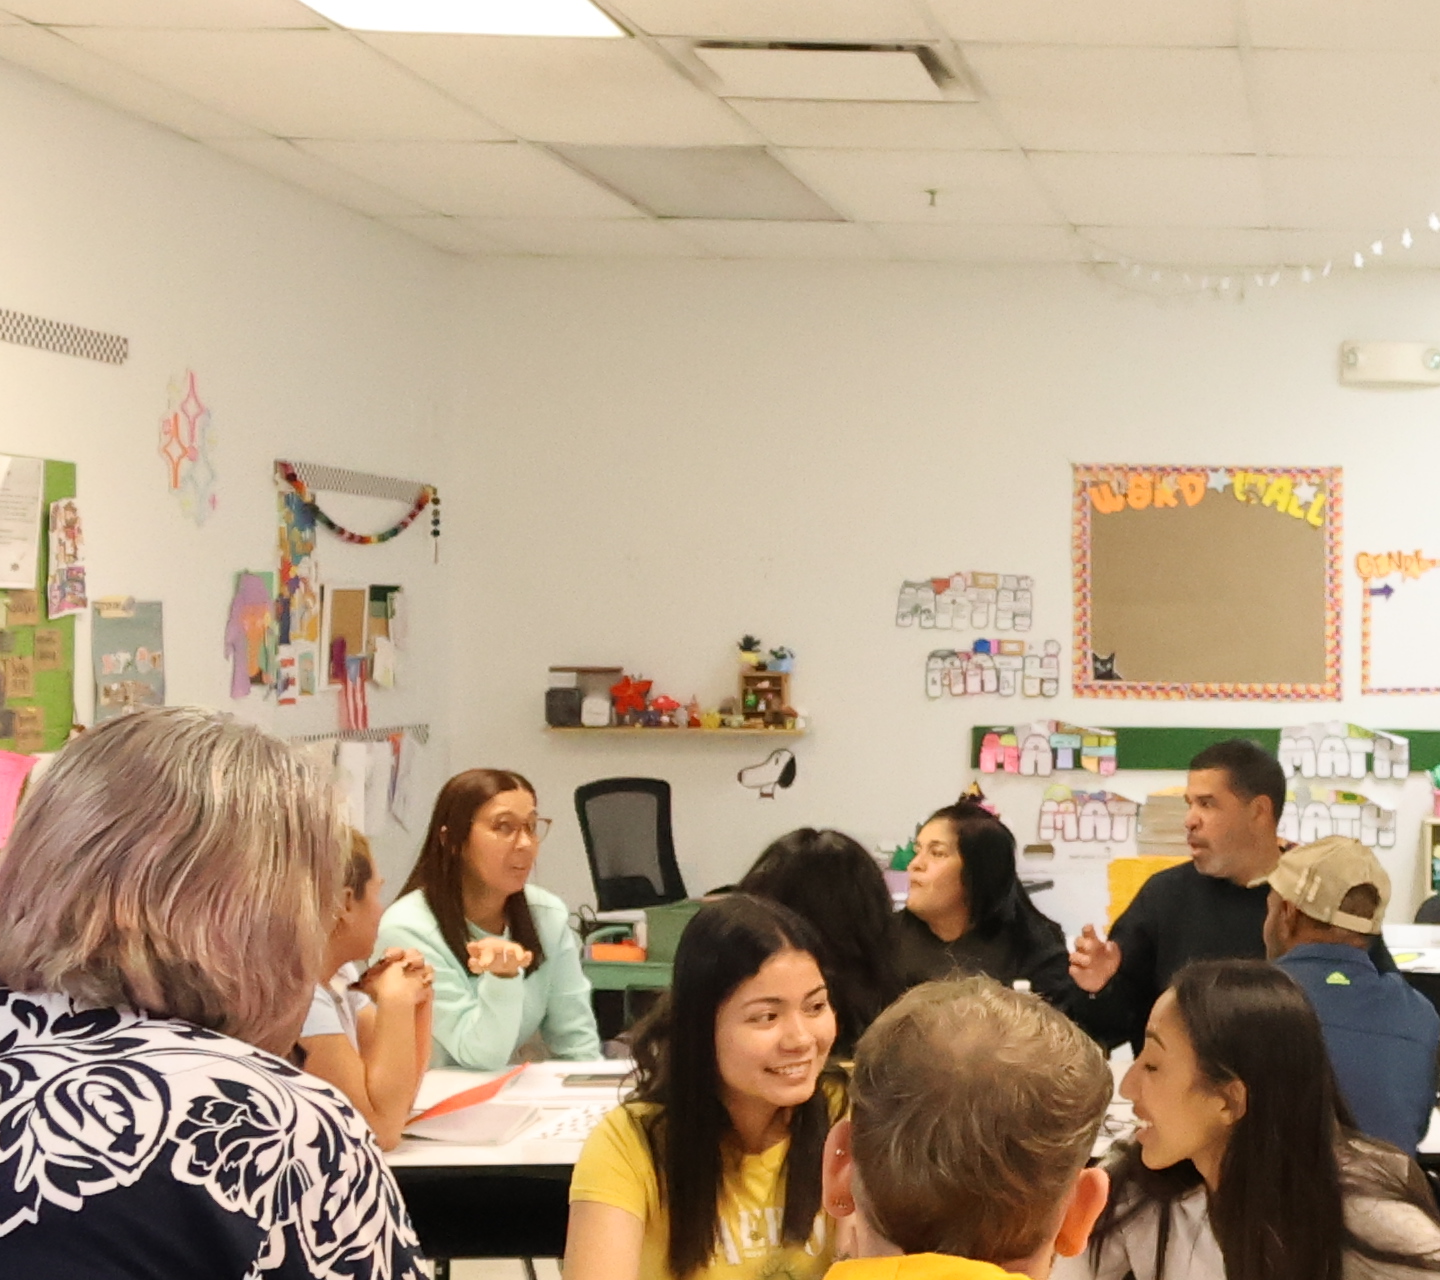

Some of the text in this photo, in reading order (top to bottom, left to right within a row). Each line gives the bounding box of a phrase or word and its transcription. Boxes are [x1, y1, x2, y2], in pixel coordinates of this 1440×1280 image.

[1088, 471, 1326, 527] WORD WALL
[979, 731, 1118, 778] MATH
[1038, 796, 1140, 843] MAT
